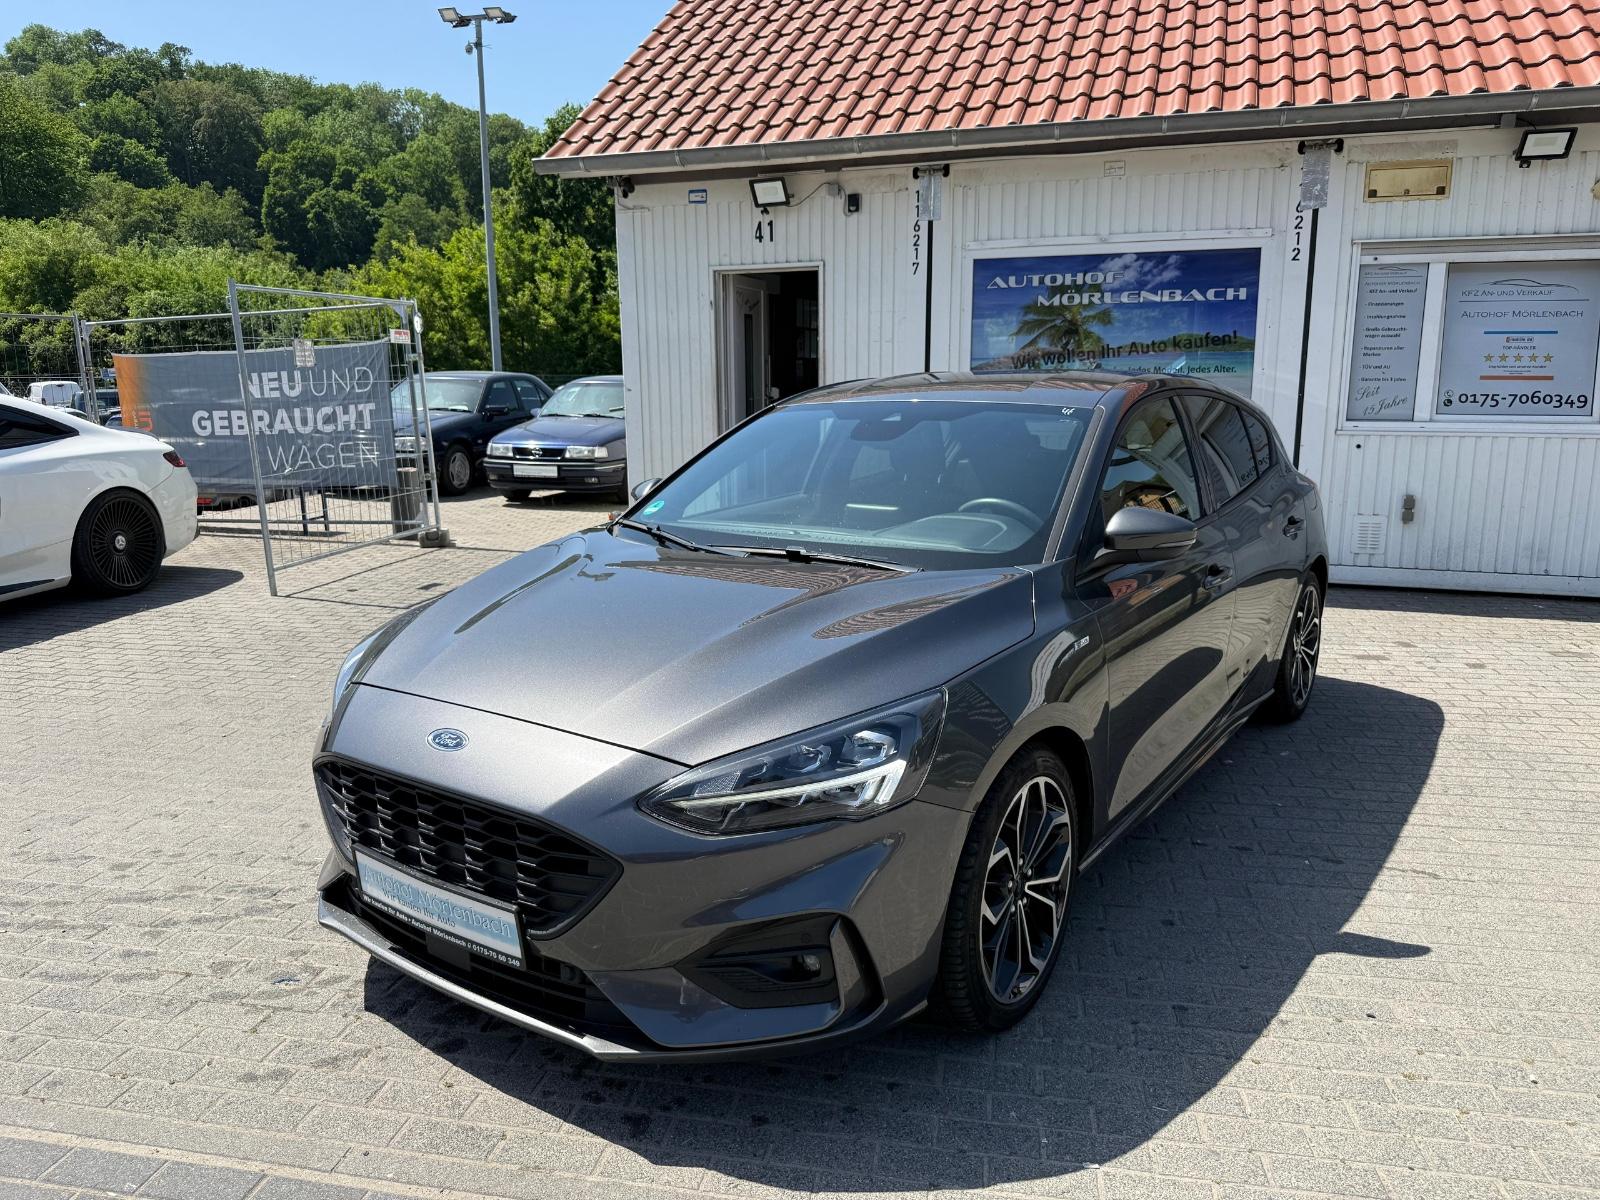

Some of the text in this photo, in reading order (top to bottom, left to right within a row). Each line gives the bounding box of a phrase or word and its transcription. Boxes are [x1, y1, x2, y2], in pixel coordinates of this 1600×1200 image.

[755, 219, 774, 243] 41
[986, 271, 1125, 289] AUTOHOF
[1037, 287, 1247, 307] MÖRLENBACH
[1461, 289, 1480, 297] KFZ
[1101, 344, 1122, 359] Ihr
[1128, 338, 1168, 356] Auto
[1172, 330, 1238, 350] kaufen!
[1187, 364, 1211, 375] Jedes
[1213, 363, 1238, 374] Alter.
[238, 366, 373, 399] NEU UND
[1355, 386, 1380, 401] Seit
[1458, 390, 1588, 409] 0175-7060349
[191, 402, 376, 437] GEBRAUCHT
[266, 440, 379, 471] WAGEN
[435, 733, 461, 747] Ford
